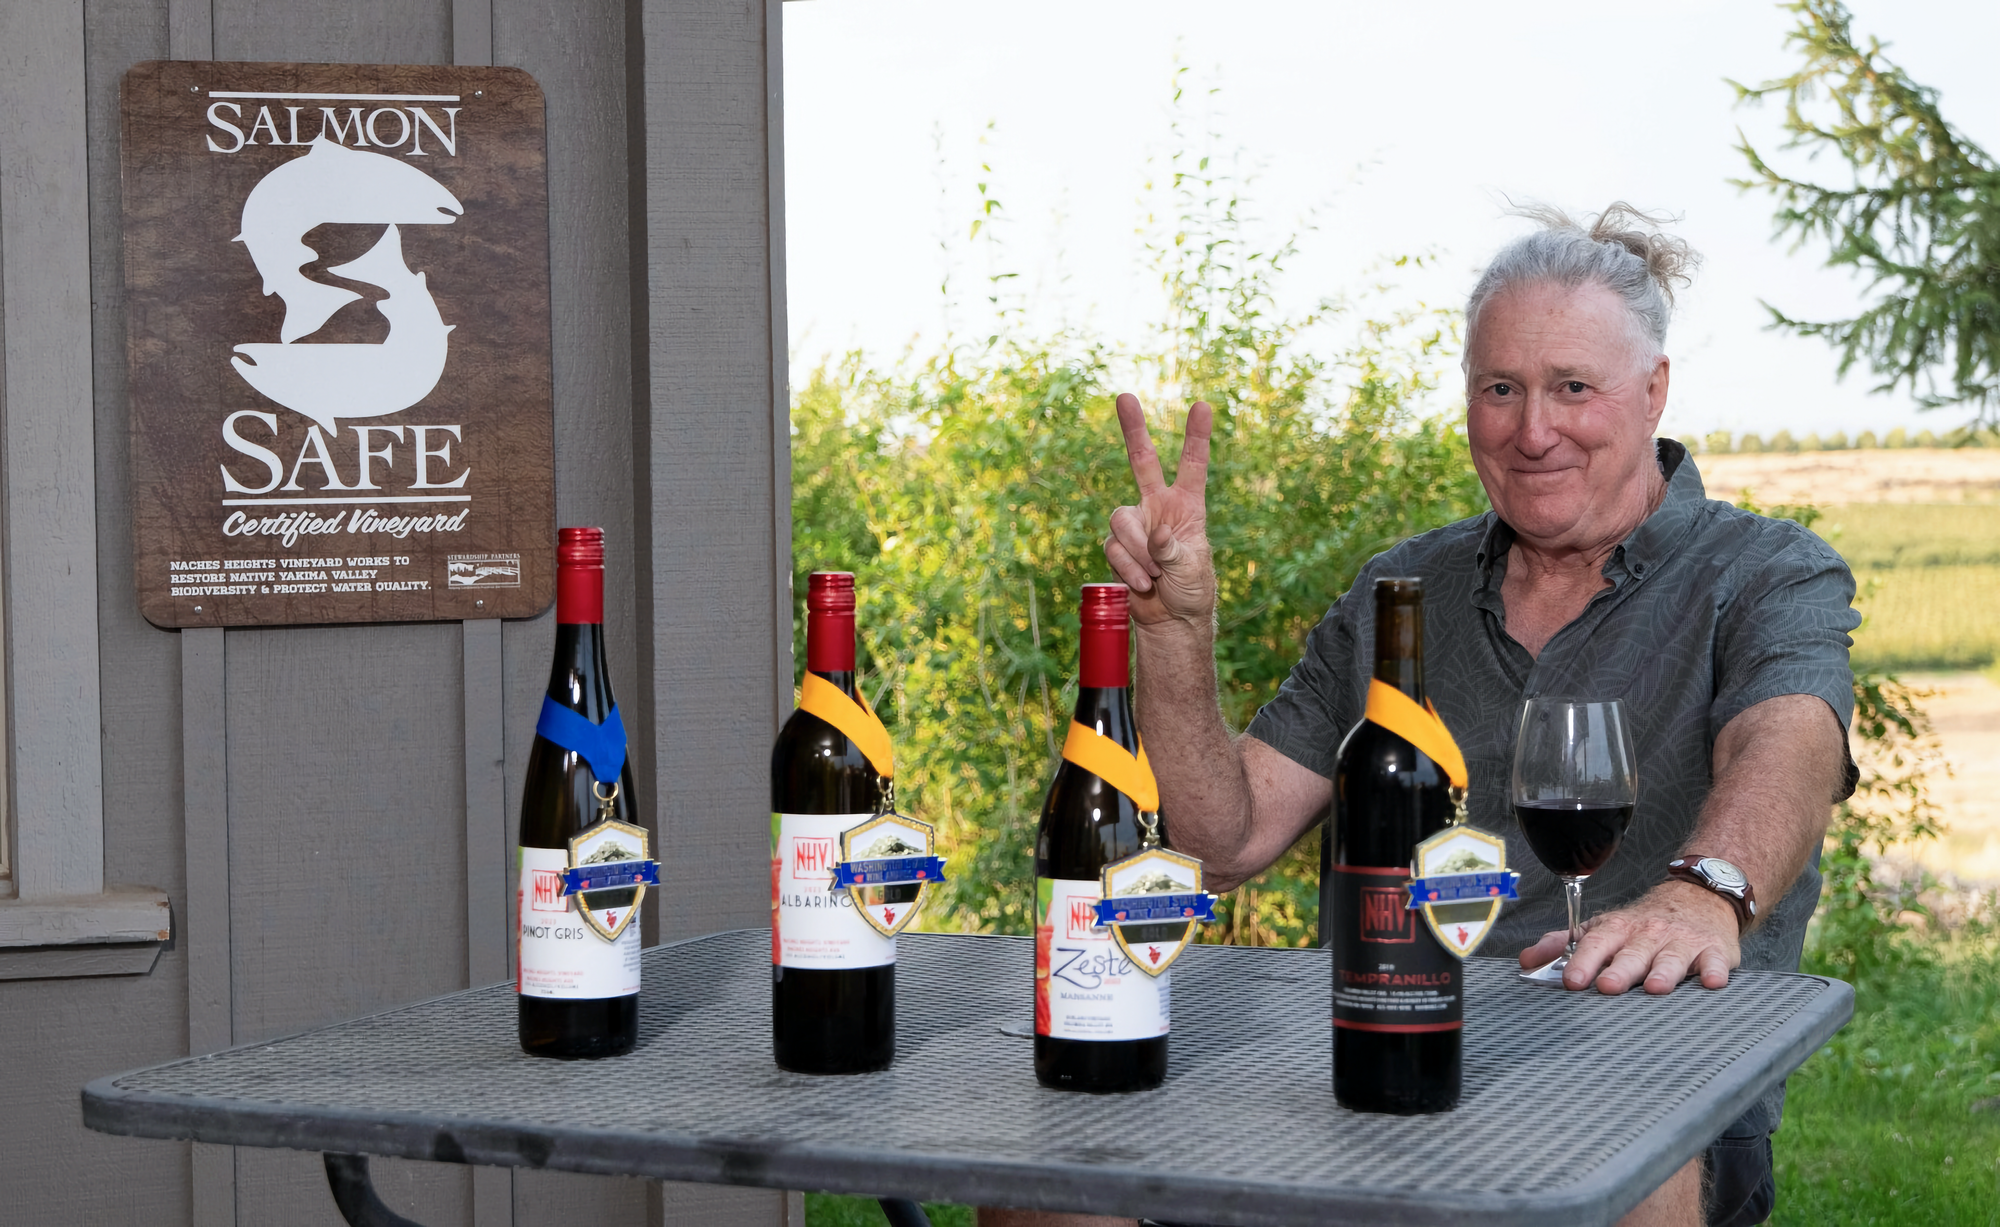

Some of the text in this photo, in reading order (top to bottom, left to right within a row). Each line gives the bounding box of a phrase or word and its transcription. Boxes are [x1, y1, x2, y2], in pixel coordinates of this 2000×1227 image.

[206, 101, 462, 157] SALMON
[220, 410, 471, 494] SAFE
[222, 508, 470, 547] Certified Vineyard
[170, 556, 410, 571] NACHES HEIGHTS VINEYARD WORKS TO
[170, 569, 378, 584] RESTORE NATIVE YAKIMA VALLEY
[171, 581, 432, 596] BIODIVERSITY & PROTECT WATER QUALITY.
[797, 842, 828, 871] NHV
[1365, 893, 1405, 932] NHV
[523, 924, 584, 940] PINOT GRIS
[1339, 970, 1451, 987] TEMPRANILLO
